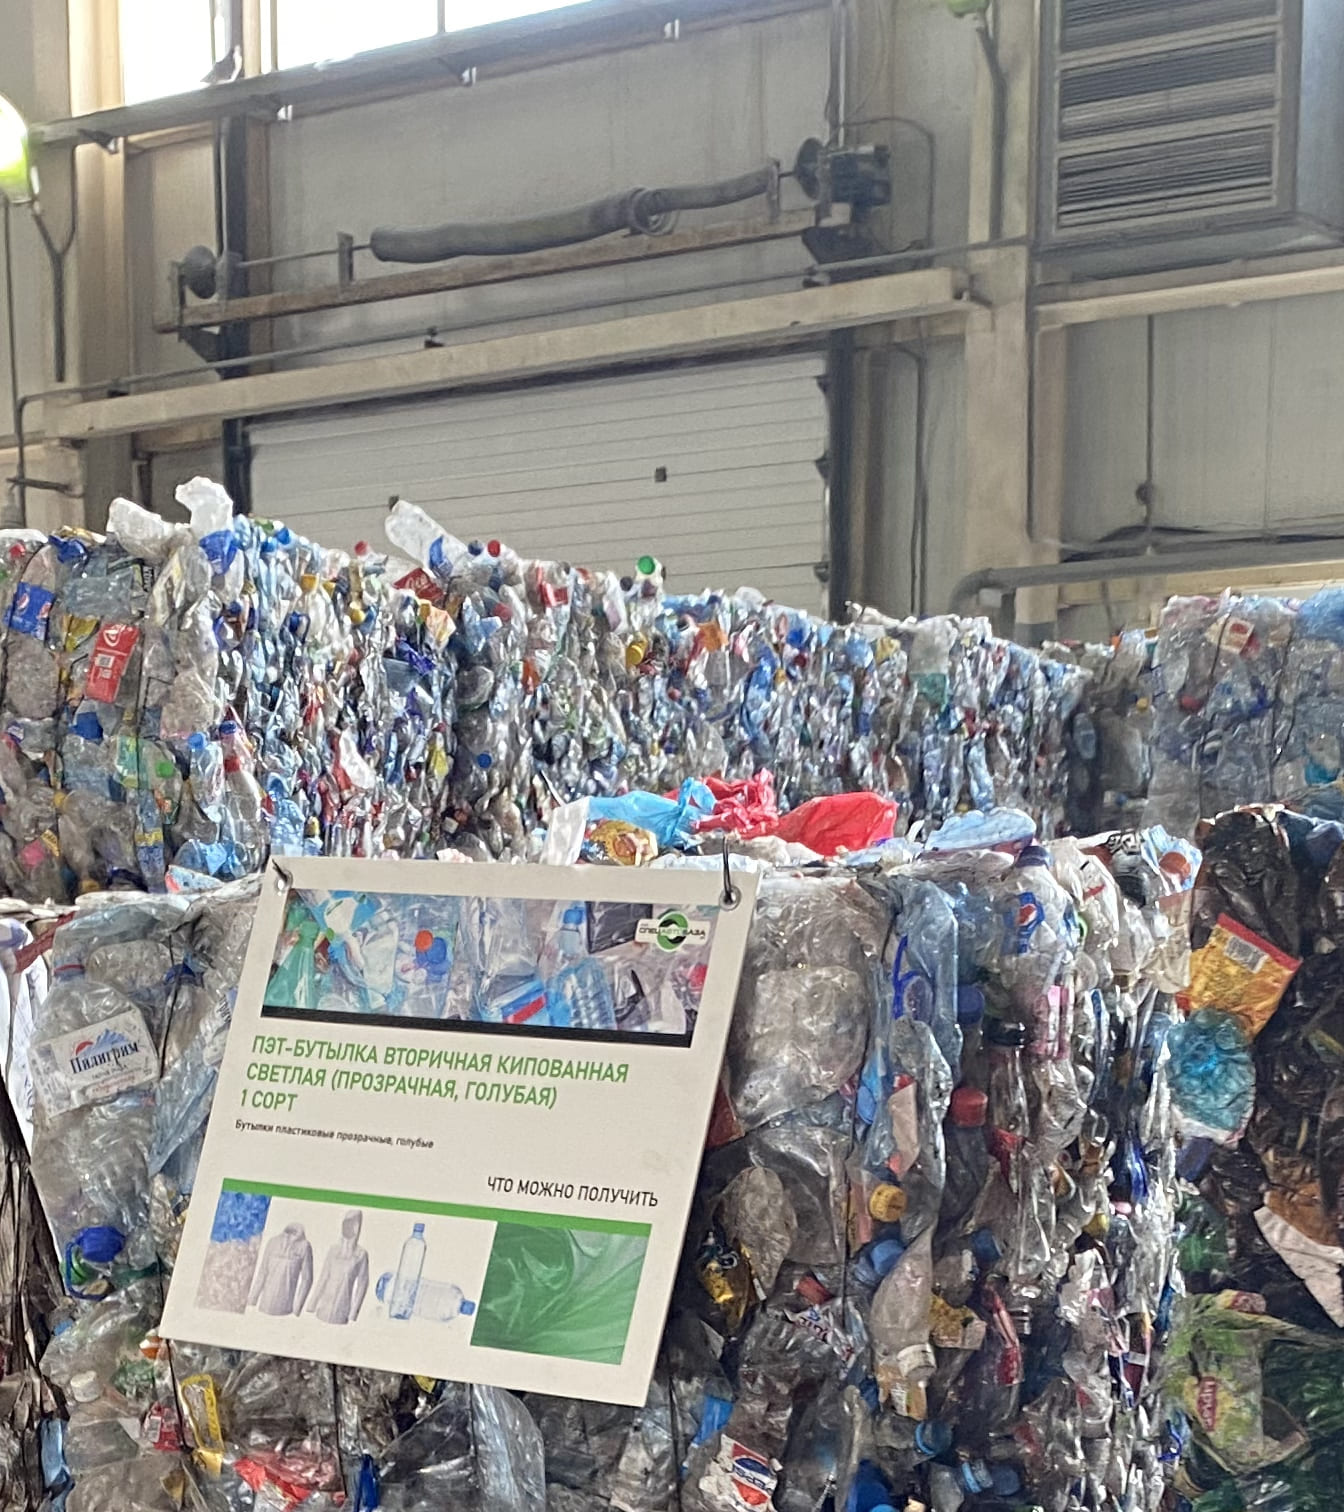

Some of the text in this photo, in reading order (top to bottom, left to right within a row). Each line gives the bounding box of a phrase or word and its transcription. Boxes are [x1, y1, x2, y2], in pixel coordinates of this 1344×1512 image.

[70, 1042, 140, 1074] Пилигрим
[251, 1034, 629, 1083] ПЭТ-БУТЫЛКА ВТОРИЧНАЯ КИПОВАННАЯ
[239, 1088, 298, 1112] 1 СОРТ
[246, 1062, 558, 1110] СВЕТЛАЯ (ПРОЗРАЧНАЯ, ГОЛУБАЯ)
[235, 1118, 274, 1132] Бутылки
[275, 1125, 335, 1140] пластиковые
[396, 1136, 435, 1149] голубые
[487, 1176, 659, 1208] ЧТО МОЖНО ПОЛУЧИТЬ
